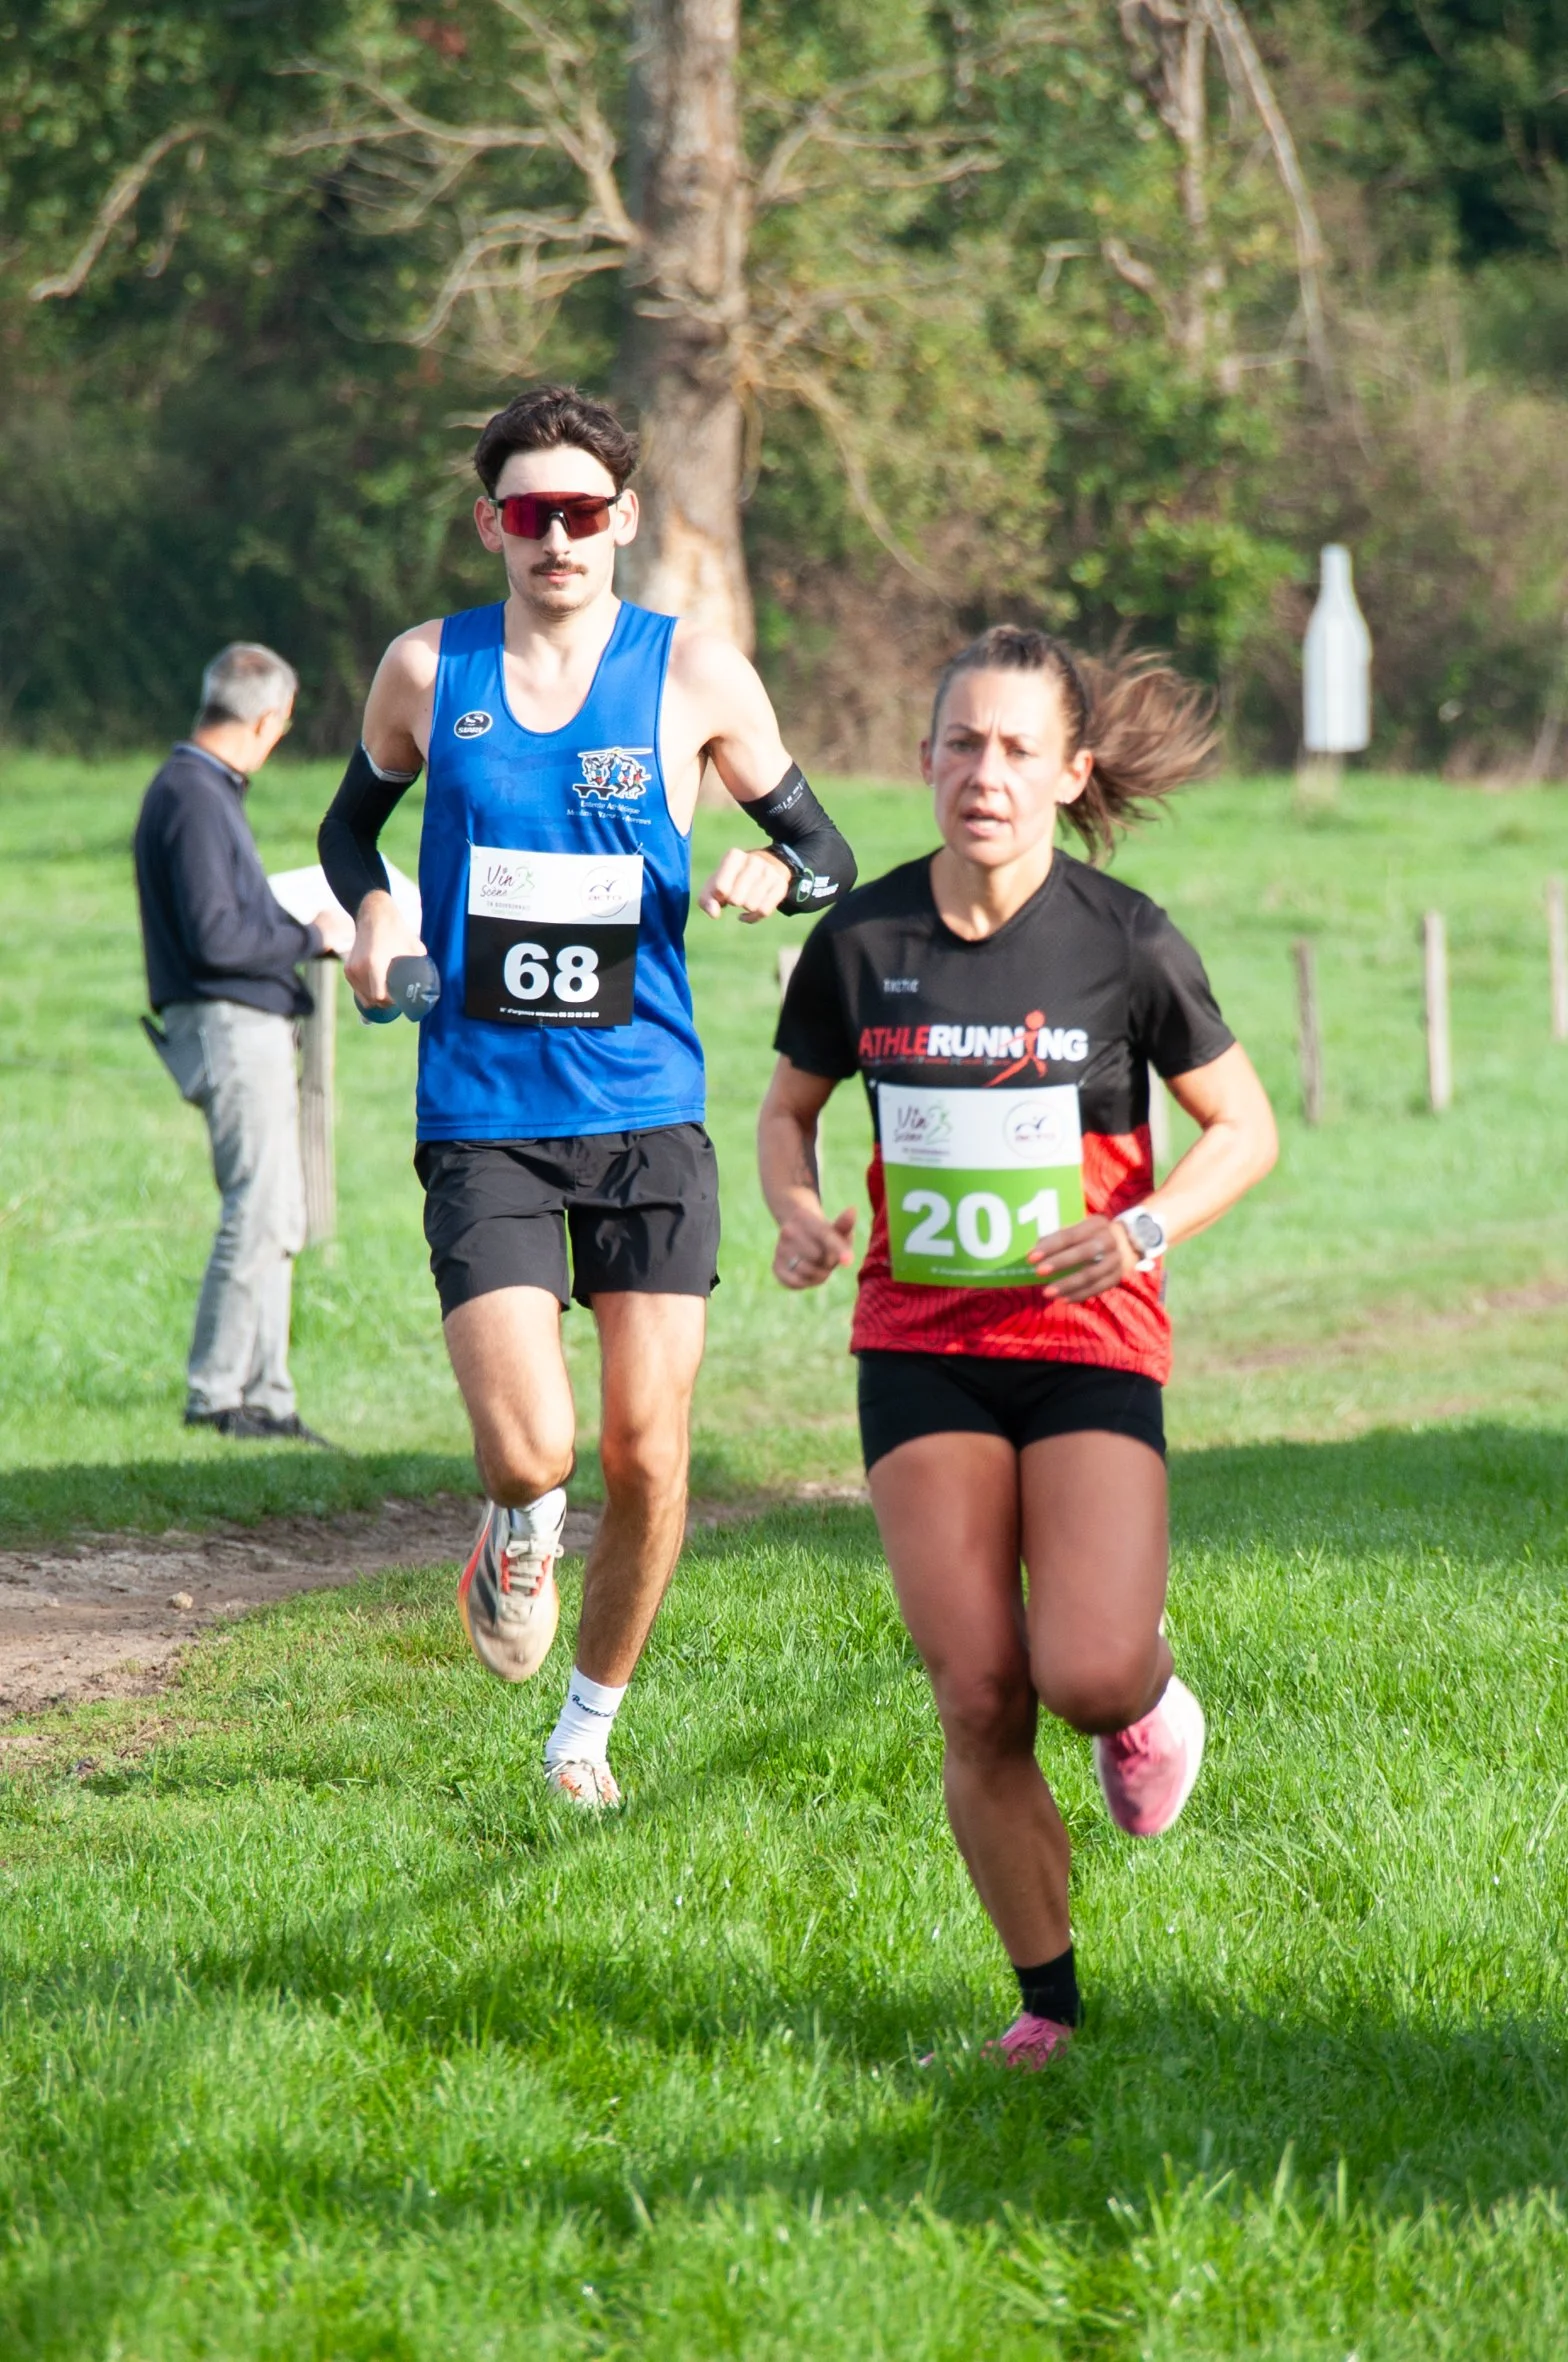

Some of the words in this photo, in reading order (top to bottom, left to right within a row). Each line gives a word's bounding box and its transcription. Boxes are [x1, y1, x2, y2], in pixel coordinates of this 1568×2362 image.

[487, 864, 514, 887] Vin
[504, 943, 600, 1003] 68
[902, 1188, 1061, 1260] 201
